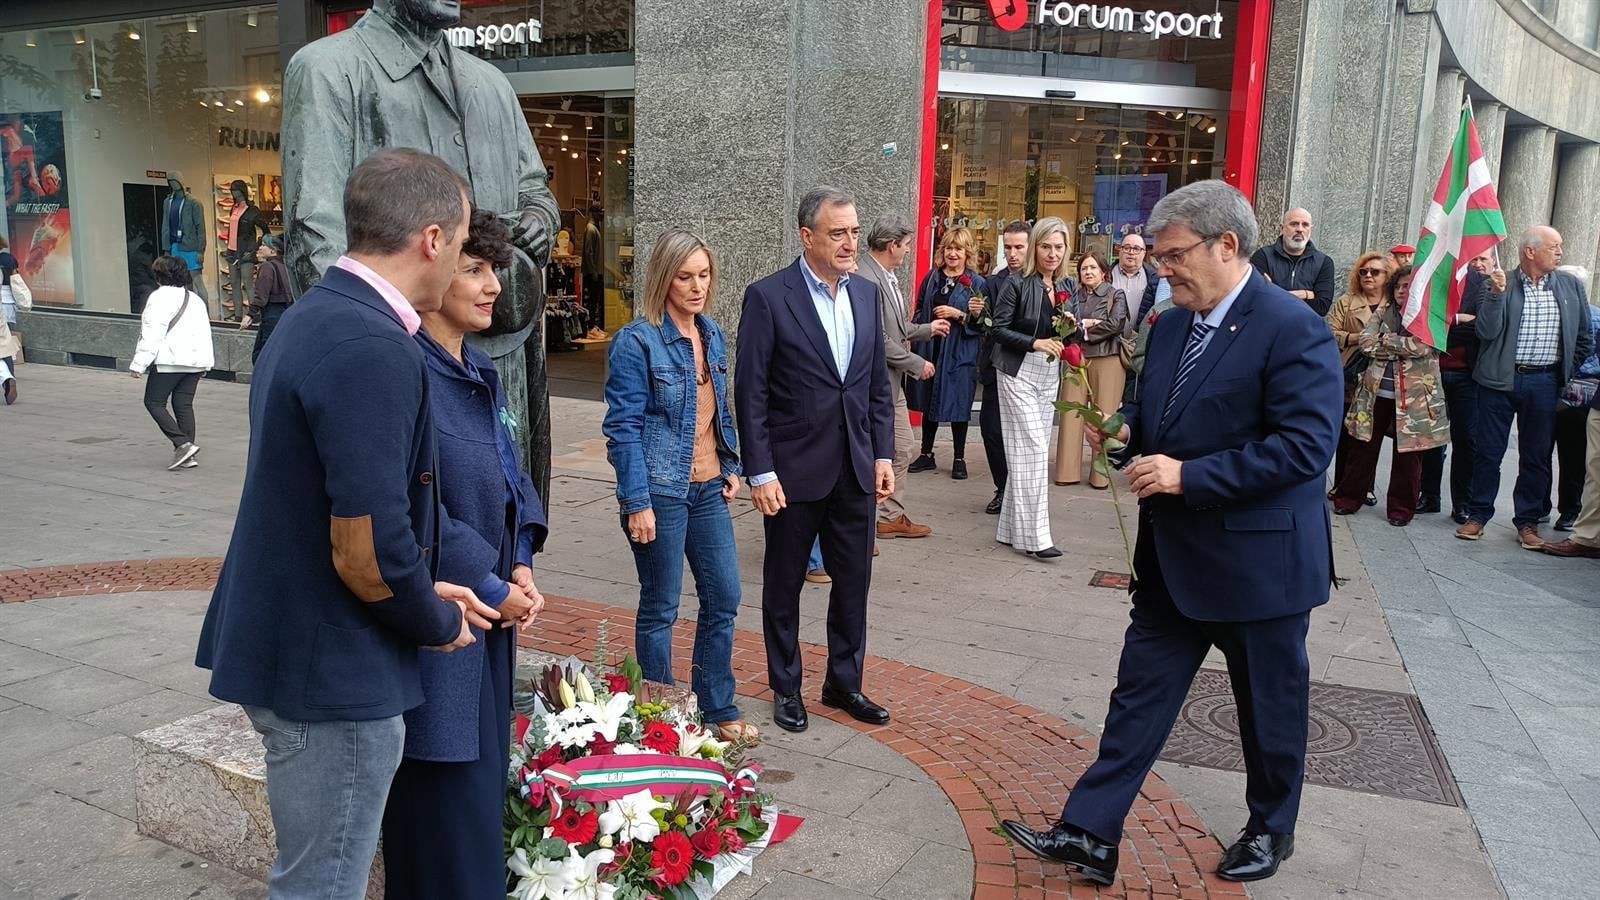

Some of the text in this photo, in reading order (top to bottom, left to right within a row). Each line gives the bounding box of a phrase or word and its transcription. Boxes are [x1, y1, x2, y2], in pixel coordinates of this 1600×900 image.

[476, 18, 542, 51] sport
[1038, 0, 1224, 40] Forum sport
[218, 126, 281, 152] RUNN
[15, 203, 32, 214] WHAT
